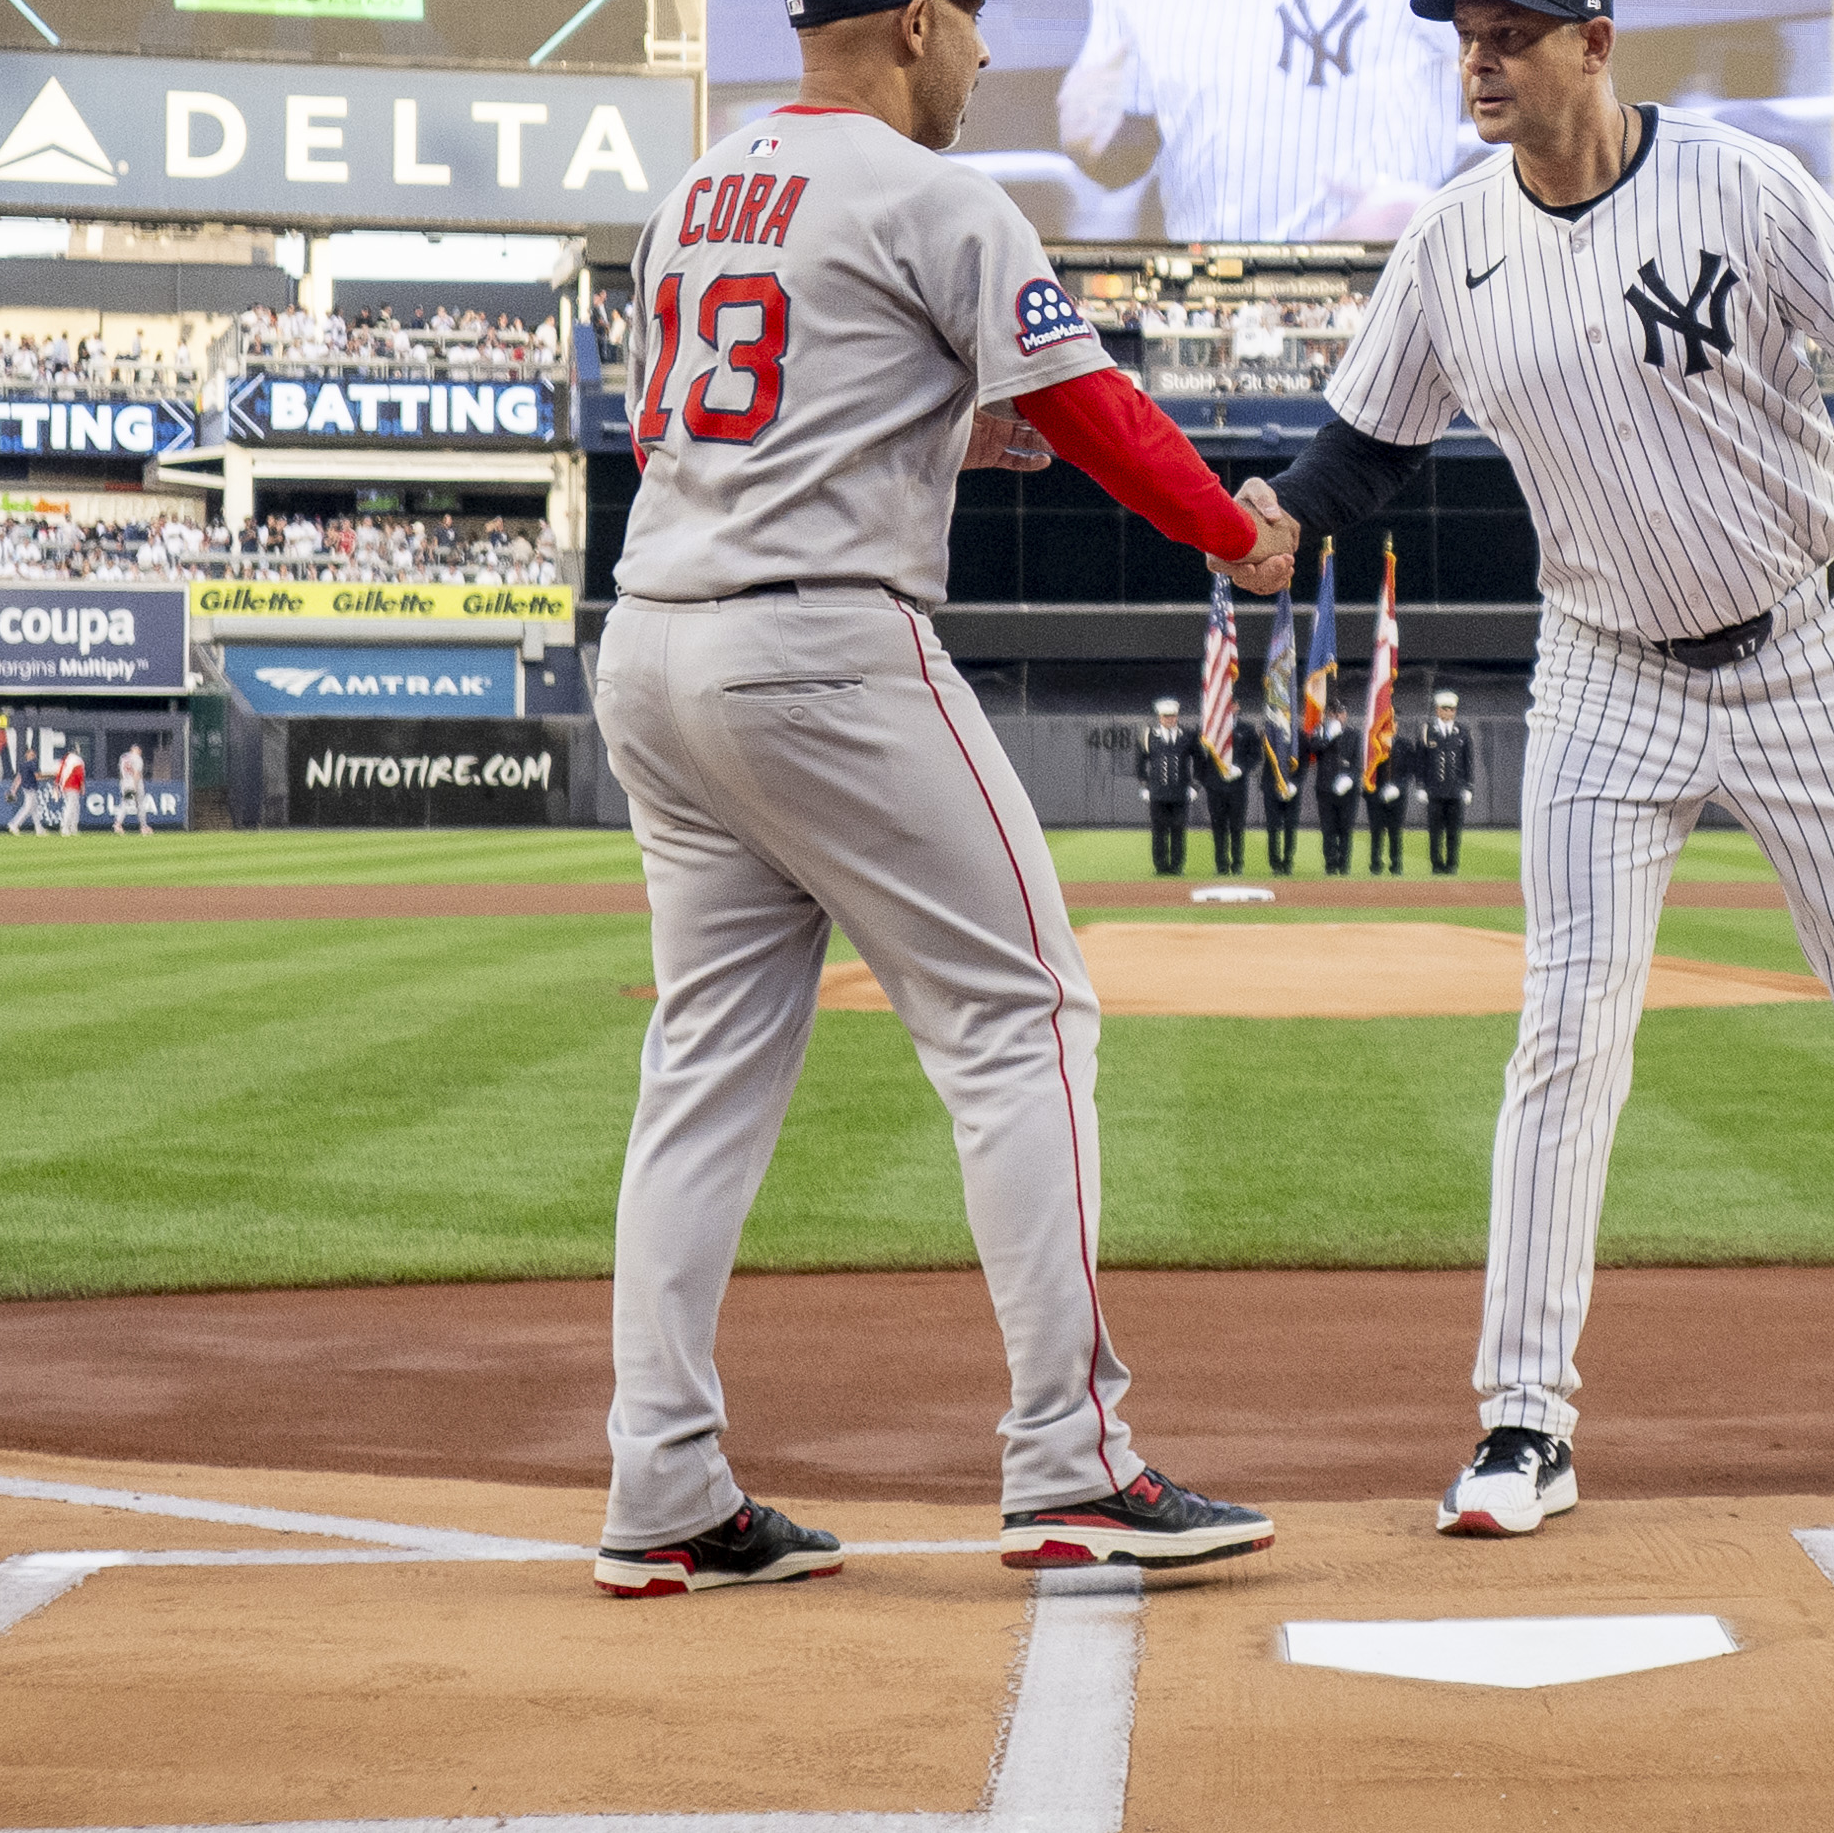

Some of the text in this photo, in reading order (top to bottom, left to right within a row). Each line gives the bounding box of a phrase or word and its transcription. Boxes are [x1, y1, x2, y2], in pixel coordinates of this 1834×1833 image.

[165, 89, 651, 193] DELTA
[678, 173, 810, 248] CORA
[638, 272, 791, 446] 13
[269, 380, 541, 436] BATTING
[199, 588, 566, 617] Gillette Gillette Gillette
[318, 674, 487, 697] AMTRAK
[305, 749, 552, 792] NITTOTIRE.COM
